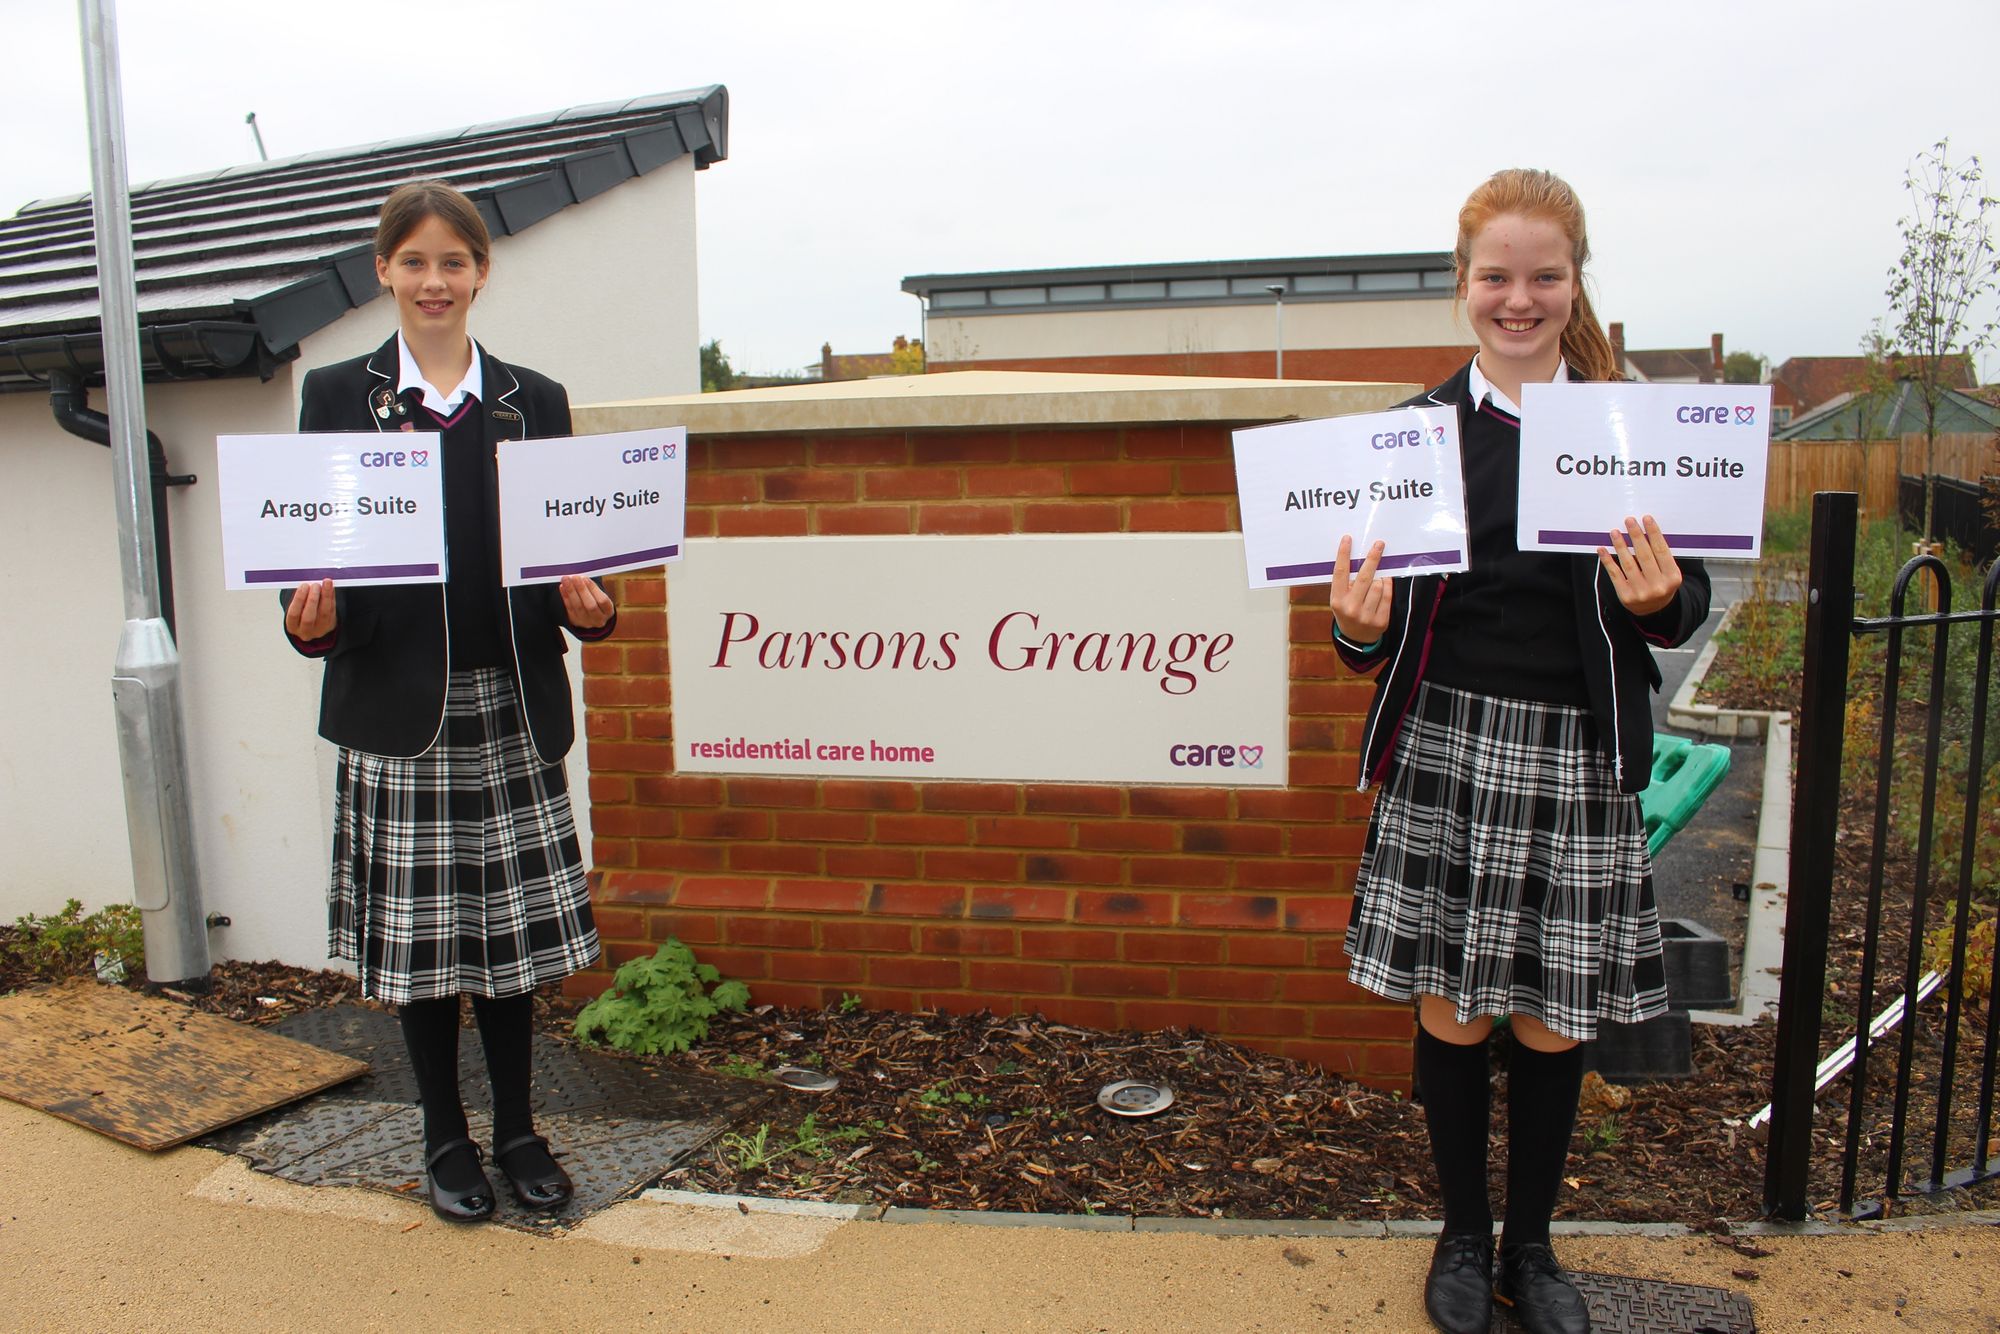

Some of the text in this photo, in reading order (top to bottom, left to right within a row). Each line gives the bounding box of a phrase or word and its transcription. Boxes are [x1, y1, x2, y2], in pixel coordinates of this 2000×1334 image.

[1676, 405, 1729, 424] care
[1371, 430, 1421, 450] care
[360, 451, 406, 468] care
[622, 446, 659, 464] care
[1555, 454, 1744, 478] Cobham Suite
[545, 489, 660, 518] Hardy Suite
[1284, 479, 1434, 511] Allfrey Suite
[260, 496, 417, 522] Arago Suite
[709, 611, 1234, 695] Parsons Grange
[690, 737, 935, 763] residential care home
[1169, 744, 1236, 767] care
